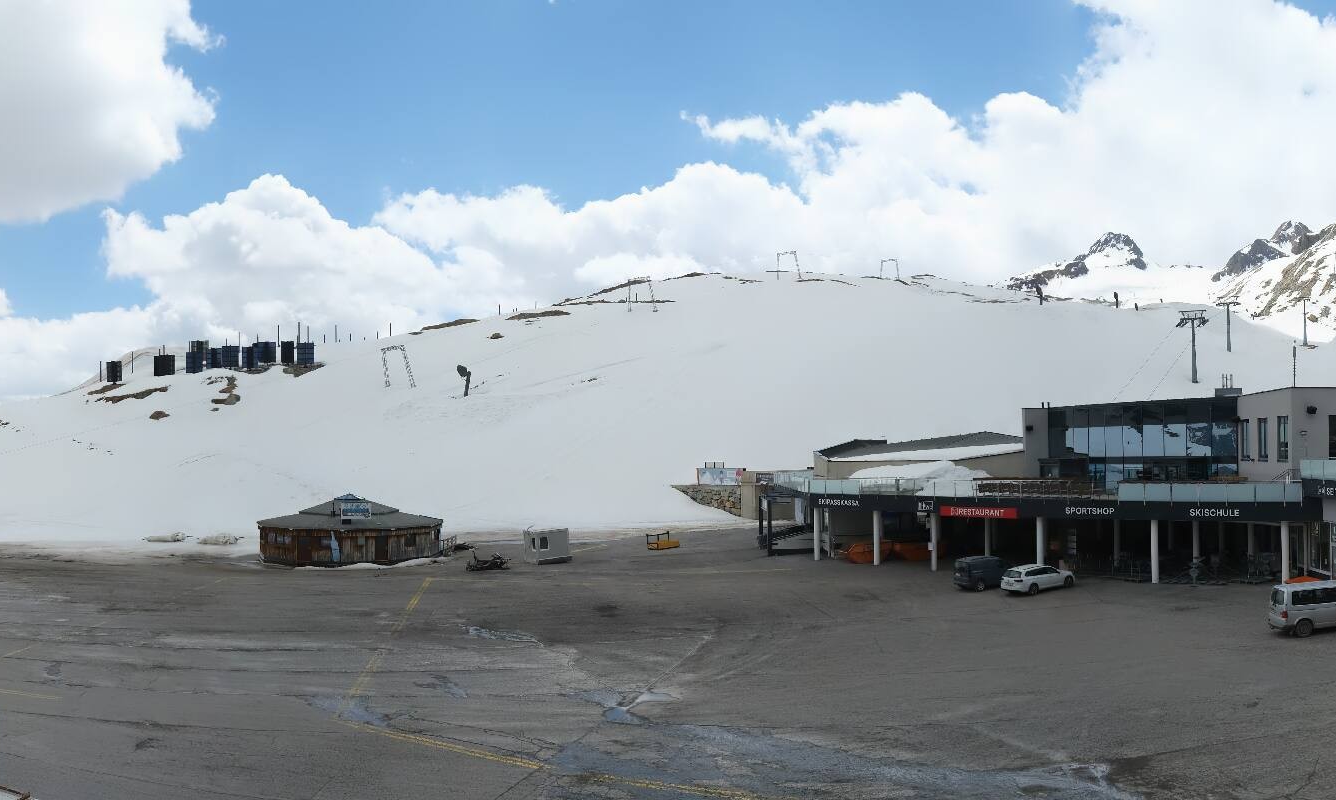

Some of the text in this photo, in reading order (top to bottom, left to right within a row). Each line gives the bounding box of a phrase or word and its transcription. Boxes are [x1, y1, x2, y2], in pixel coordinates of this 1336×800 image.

[958, 507, 1005, 517] RESTAURANT
[1065, 506, 1115, 515] SPORTSHOP
[1189, 508, 1240, 517] SKISCHULE
